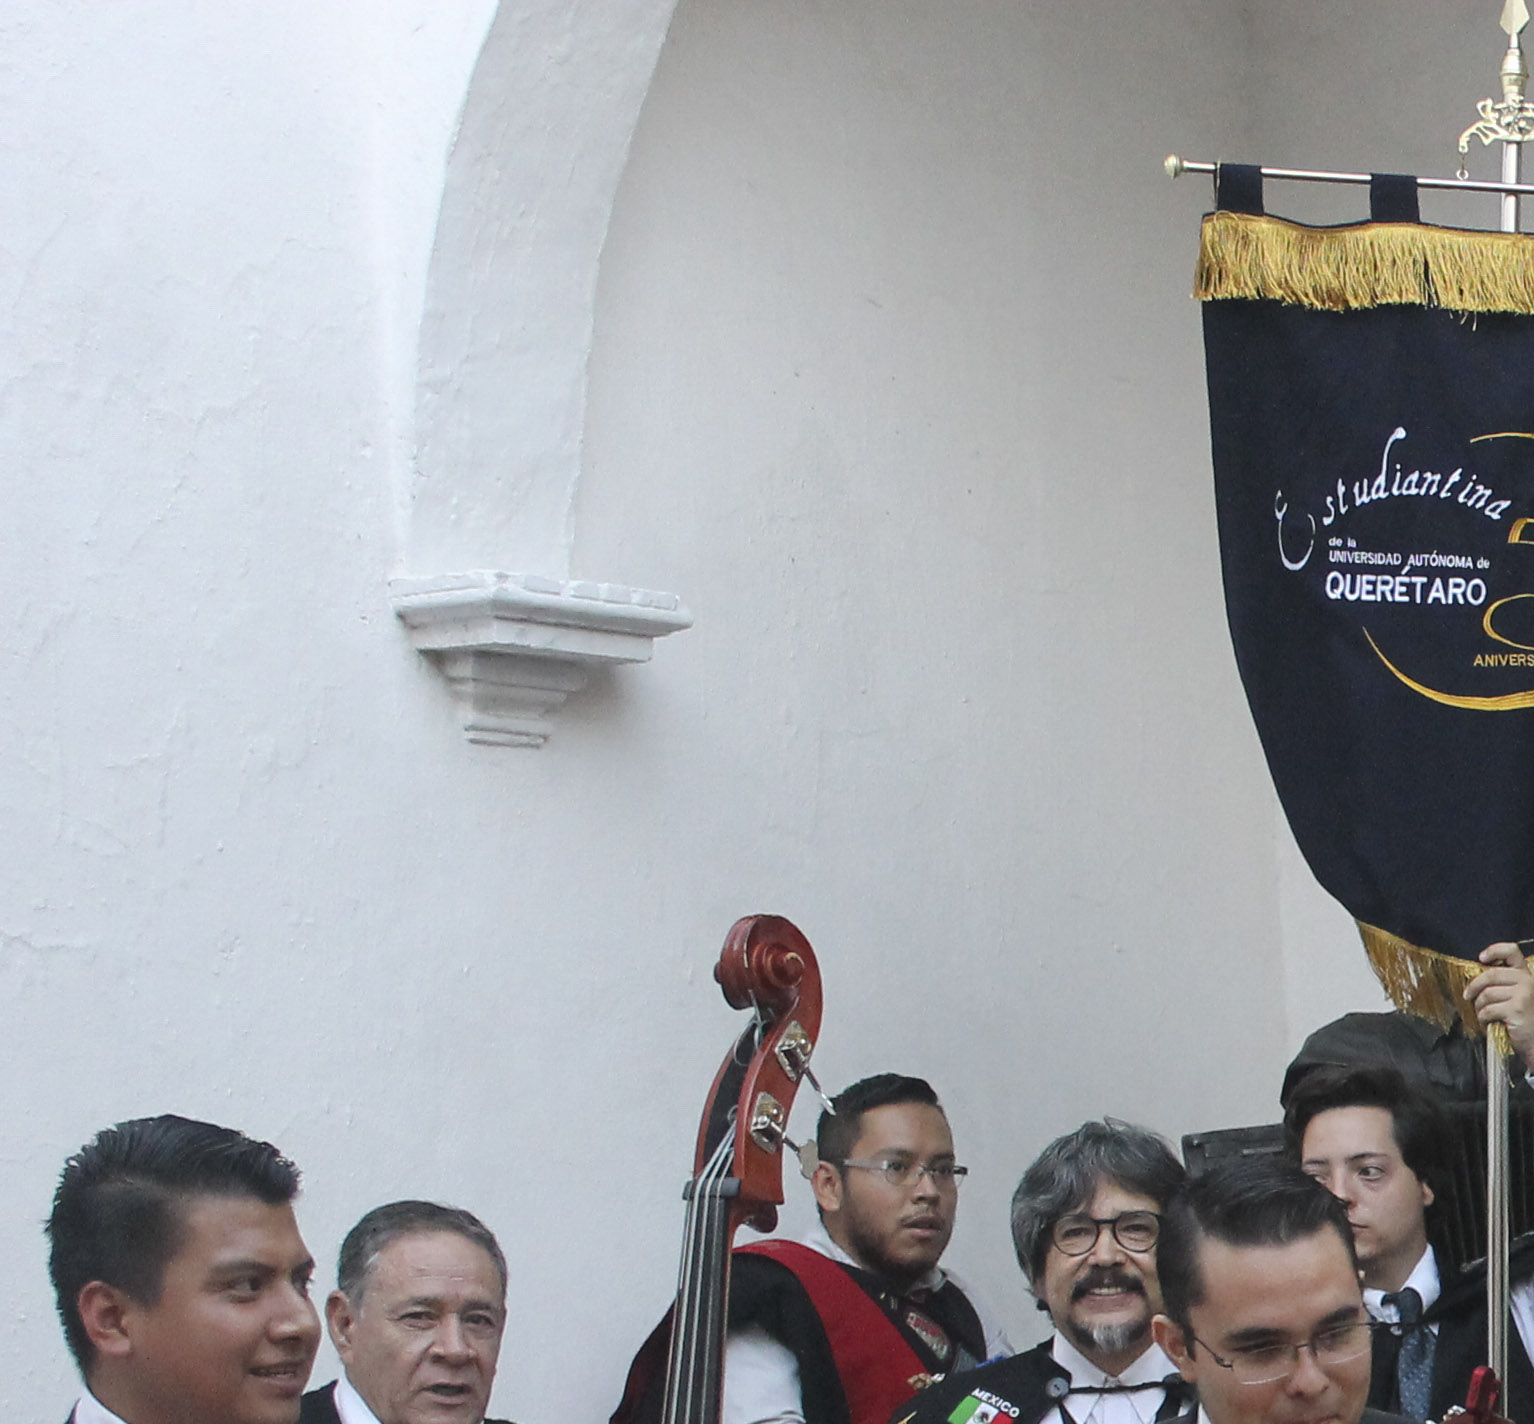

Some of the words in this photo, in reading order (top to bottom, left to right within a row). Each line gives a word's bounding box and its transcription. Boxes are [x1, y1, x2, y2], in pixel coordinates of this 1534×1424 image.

[1275, 427, 1512, 571] Estudiantina
[1328, 537, 1343, 547] de
[1347, 537, 1357, 548] la
[1329, 550, 1402, 565] UNIVERSIDAD
[1407, 550, 1474, 569] AUTÓNOMA
[1476, 556, 1490, 569] de
[1325, 565, 1487, 606] QUERÉTARO
[971, 1387, 1020, 1418] MEXICO
